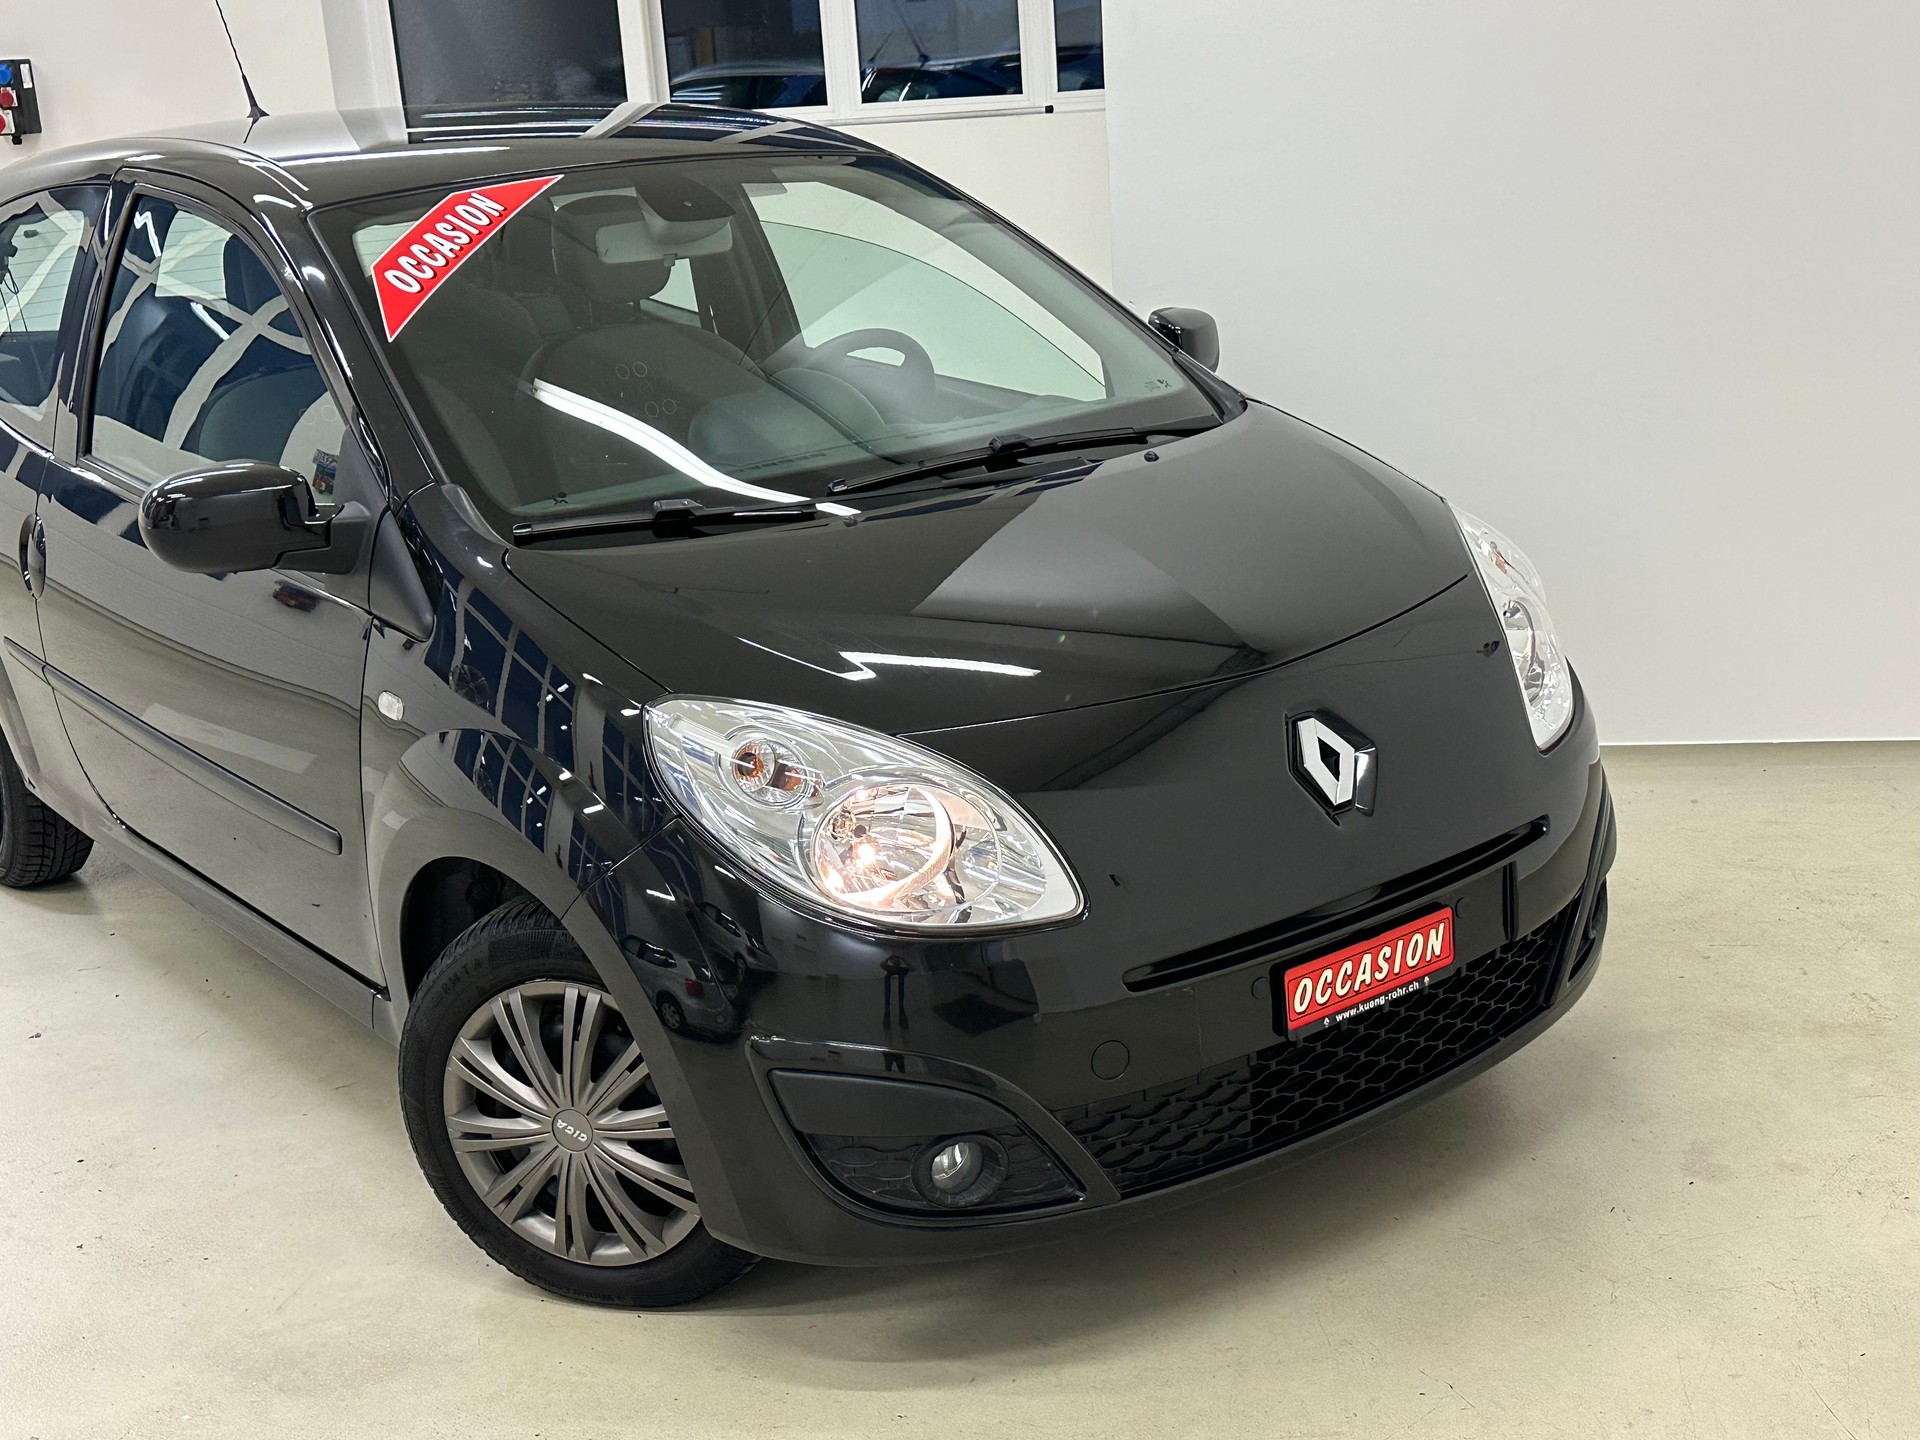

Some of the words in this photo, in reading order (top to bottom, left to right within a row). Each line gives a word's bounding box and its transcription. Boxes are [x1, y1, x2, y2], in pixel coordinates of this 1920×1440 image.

[383, 192, 506, 294] OCCASION
[1293, 921, 1446, 1014] OCCASION
[1335, 980, 1420, 1022] www.kueng-rohr.ch
